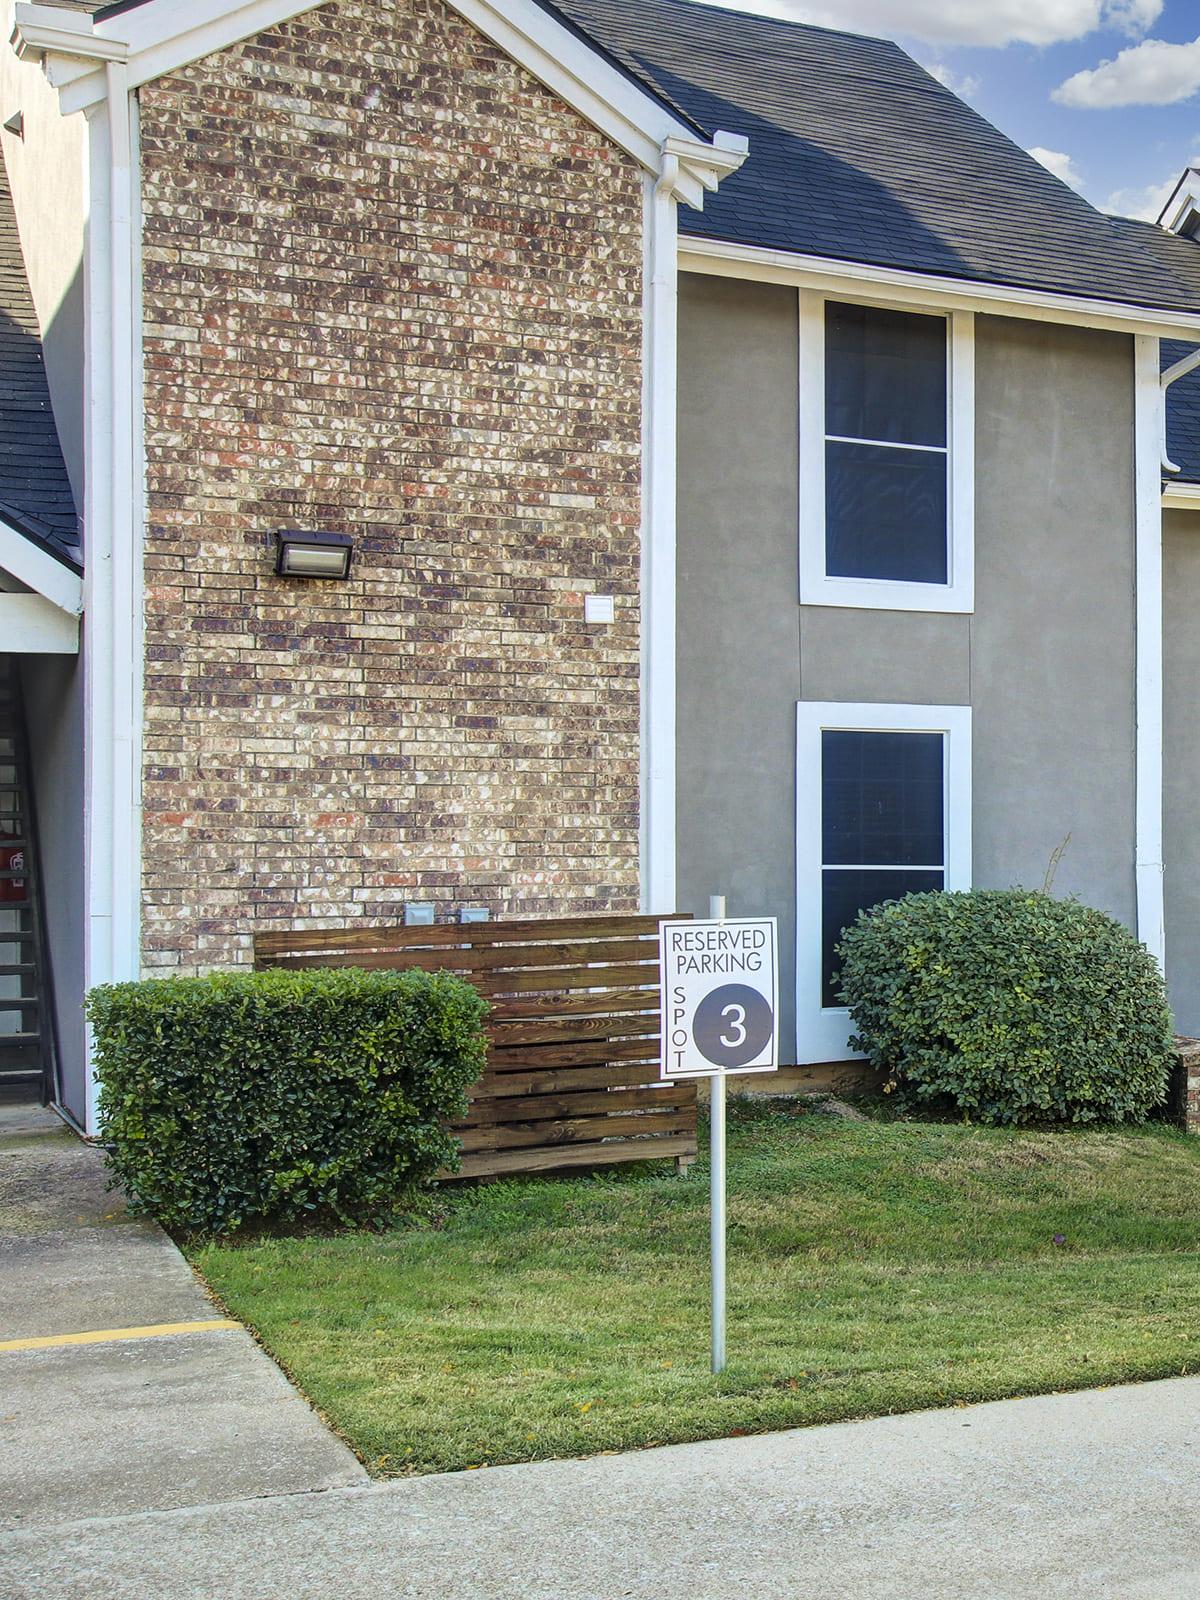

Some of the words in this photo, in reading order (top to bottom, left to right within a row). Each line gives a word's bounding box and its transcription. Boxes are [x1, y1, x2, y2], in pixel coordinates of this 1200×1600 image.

[672, 929, 766, 952] RESERVED
[677, 951, 762, 974] PARKING
[672, 986, 687, 1068] SPOT
[719, 1003, 747, 1048] 3
